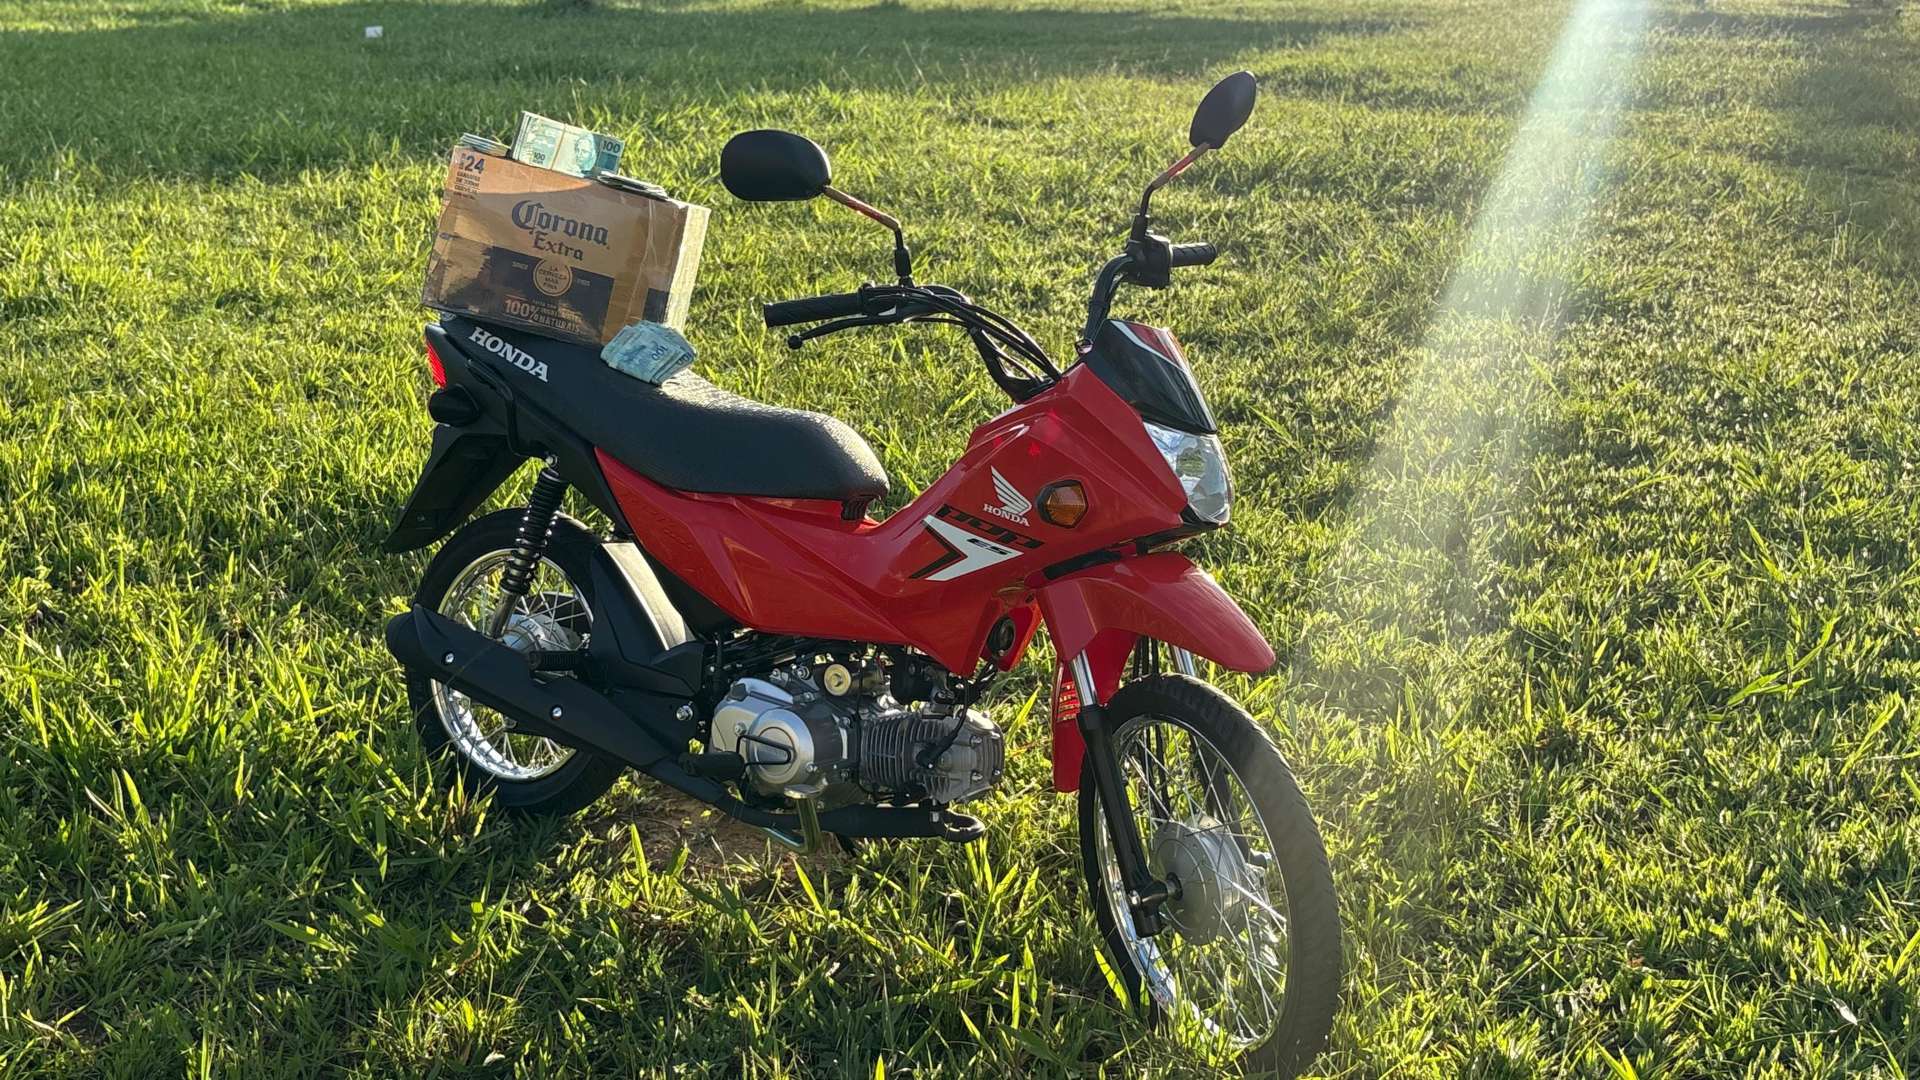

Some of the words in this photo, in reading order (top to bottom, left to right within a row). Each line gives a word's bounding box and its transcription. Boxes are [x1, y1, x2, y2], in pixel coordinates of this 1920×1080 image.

[533, 152, 546, 161] 100
[602, 140, 621, 153] 100
[464, 155, 485, 174] 24
[511, 200, 608, 246] Corona
[532, 230, 584, 261] Extra
[504, 299, 538, 321] 100%
[468, 326, 549, 383] HONDA
[651, 345, 668, 361] 100
[983, 503, 1030, 527] HONDA
